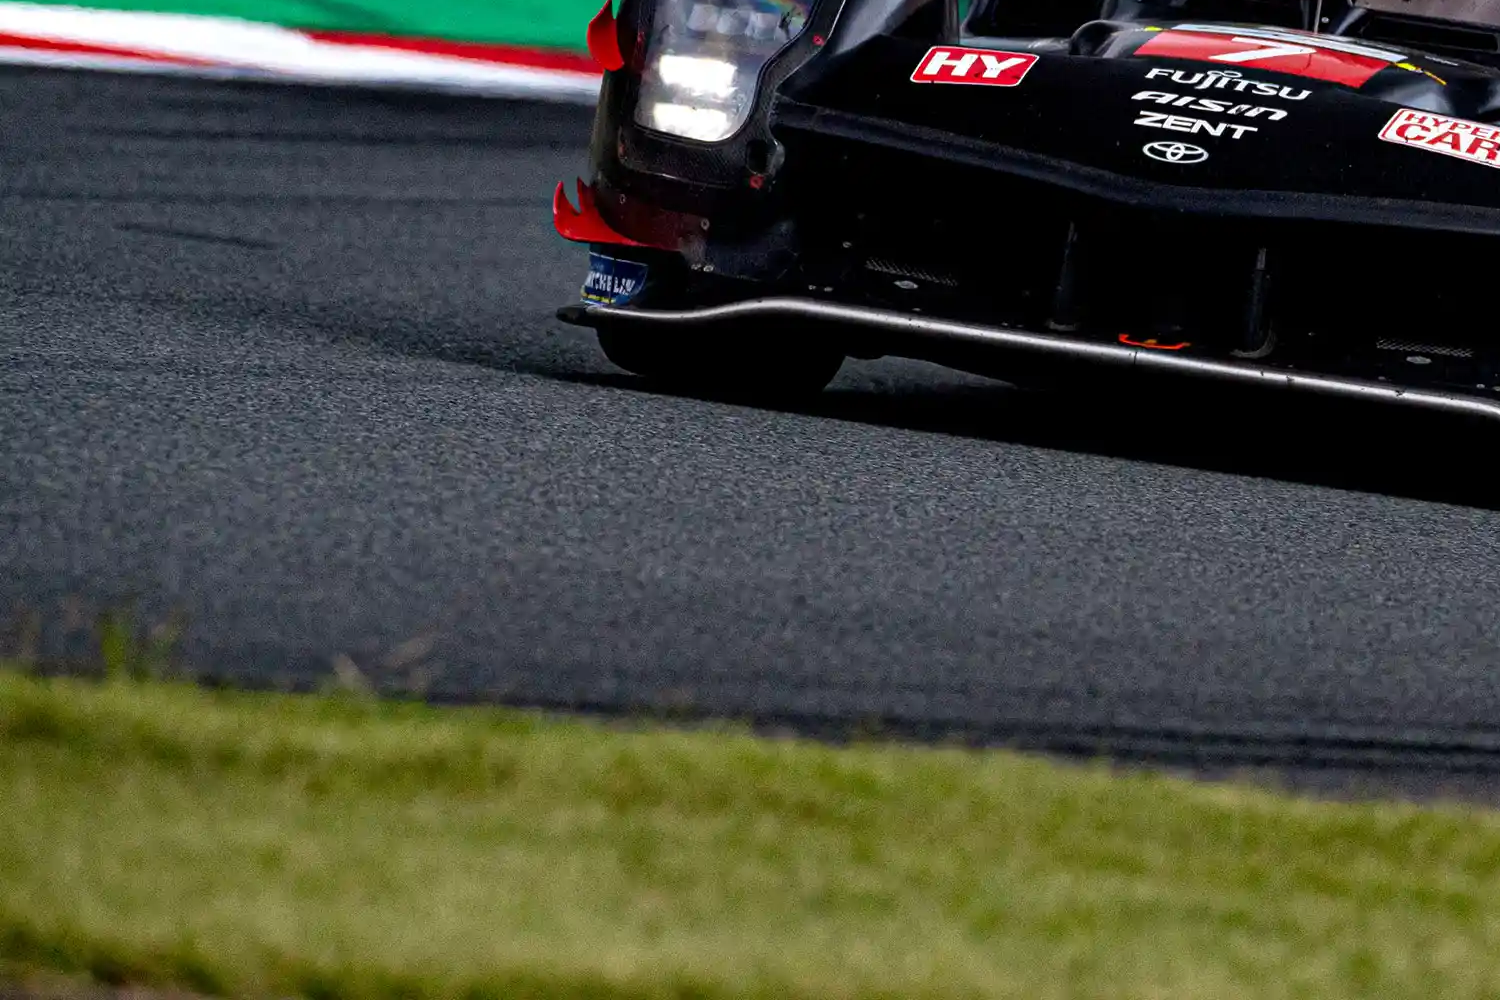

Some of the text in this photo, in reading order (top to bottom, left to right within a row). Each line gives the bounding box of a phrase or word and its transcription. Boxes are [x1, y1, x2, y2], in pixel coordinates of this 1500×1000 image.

[1208, 36, 1317, 63] 7
[922, 51, 1028, 79] HY
[1144, 67, 1313, 101] FUJITSU
[1131, 90, 1289, 121] AISIN
[1133, 110, 1259, 140] ZENT
